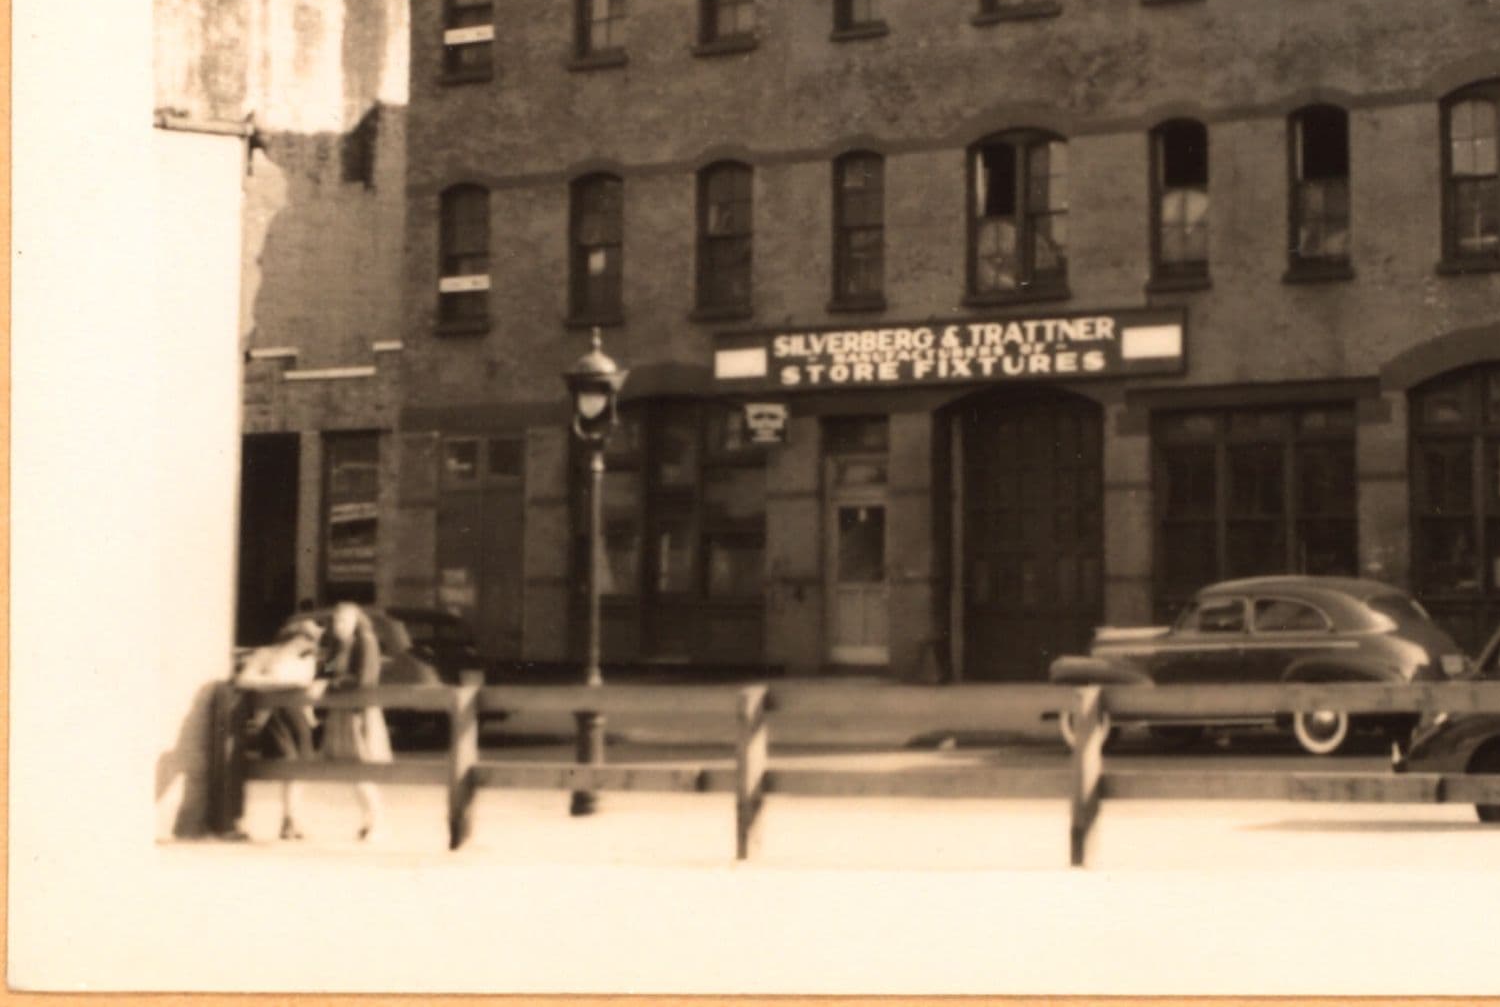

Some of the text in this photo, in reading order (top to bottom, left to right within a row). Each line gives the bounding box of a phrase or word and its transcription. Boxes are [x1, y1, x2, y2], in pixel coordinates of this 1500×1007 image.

[773, 316, 1115, 357] SILVERBERG & TRATTNER
[1018, 341, 1045, 355] OF
[780, 350, 1106, 386] STORE FIXTURES
